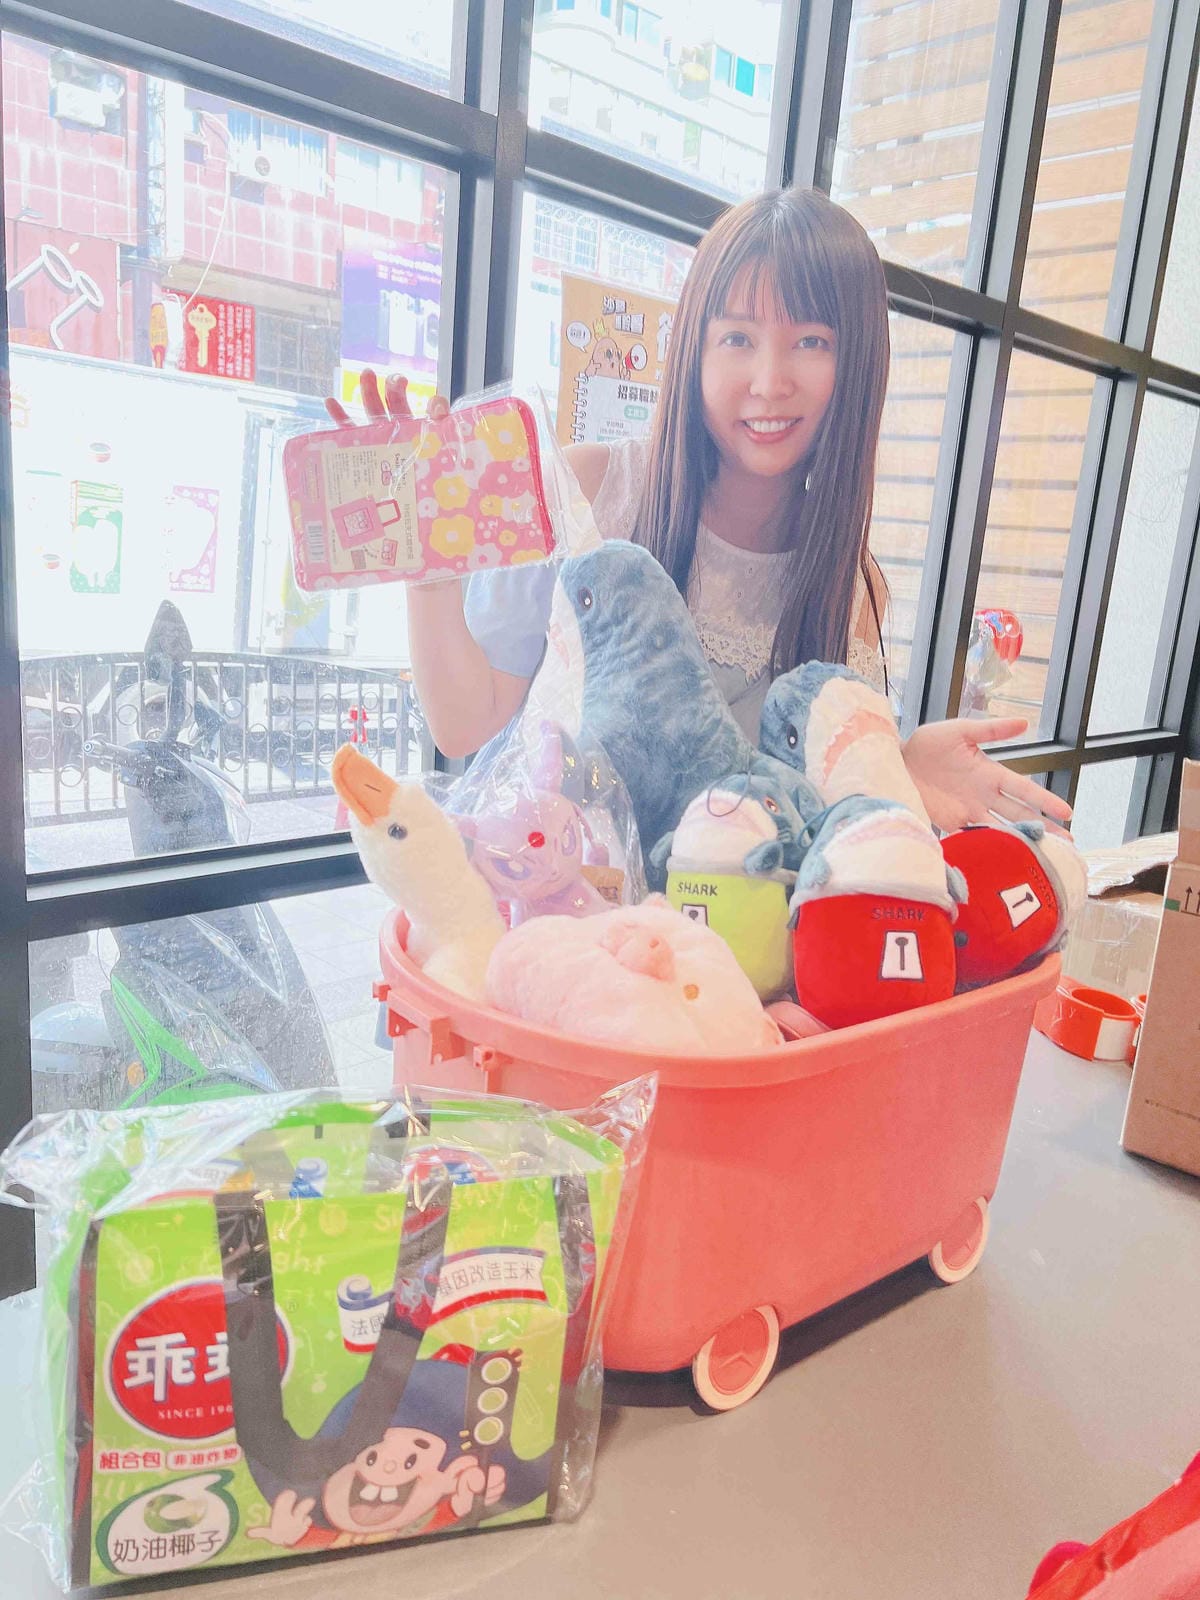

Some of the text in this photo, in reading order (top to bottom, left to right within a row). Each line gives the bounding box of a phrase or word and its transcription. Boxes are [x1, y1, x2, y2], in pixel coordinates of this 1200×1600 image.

[676, 882, 718, 896] SHARK
[872, 907, 925, 922] SHARK
[158, 1406, 204, 1420] SINCE
[99, 1452, 161, 1470] 組合包
[113, 1529, 222, 1562] 奶油椰子
